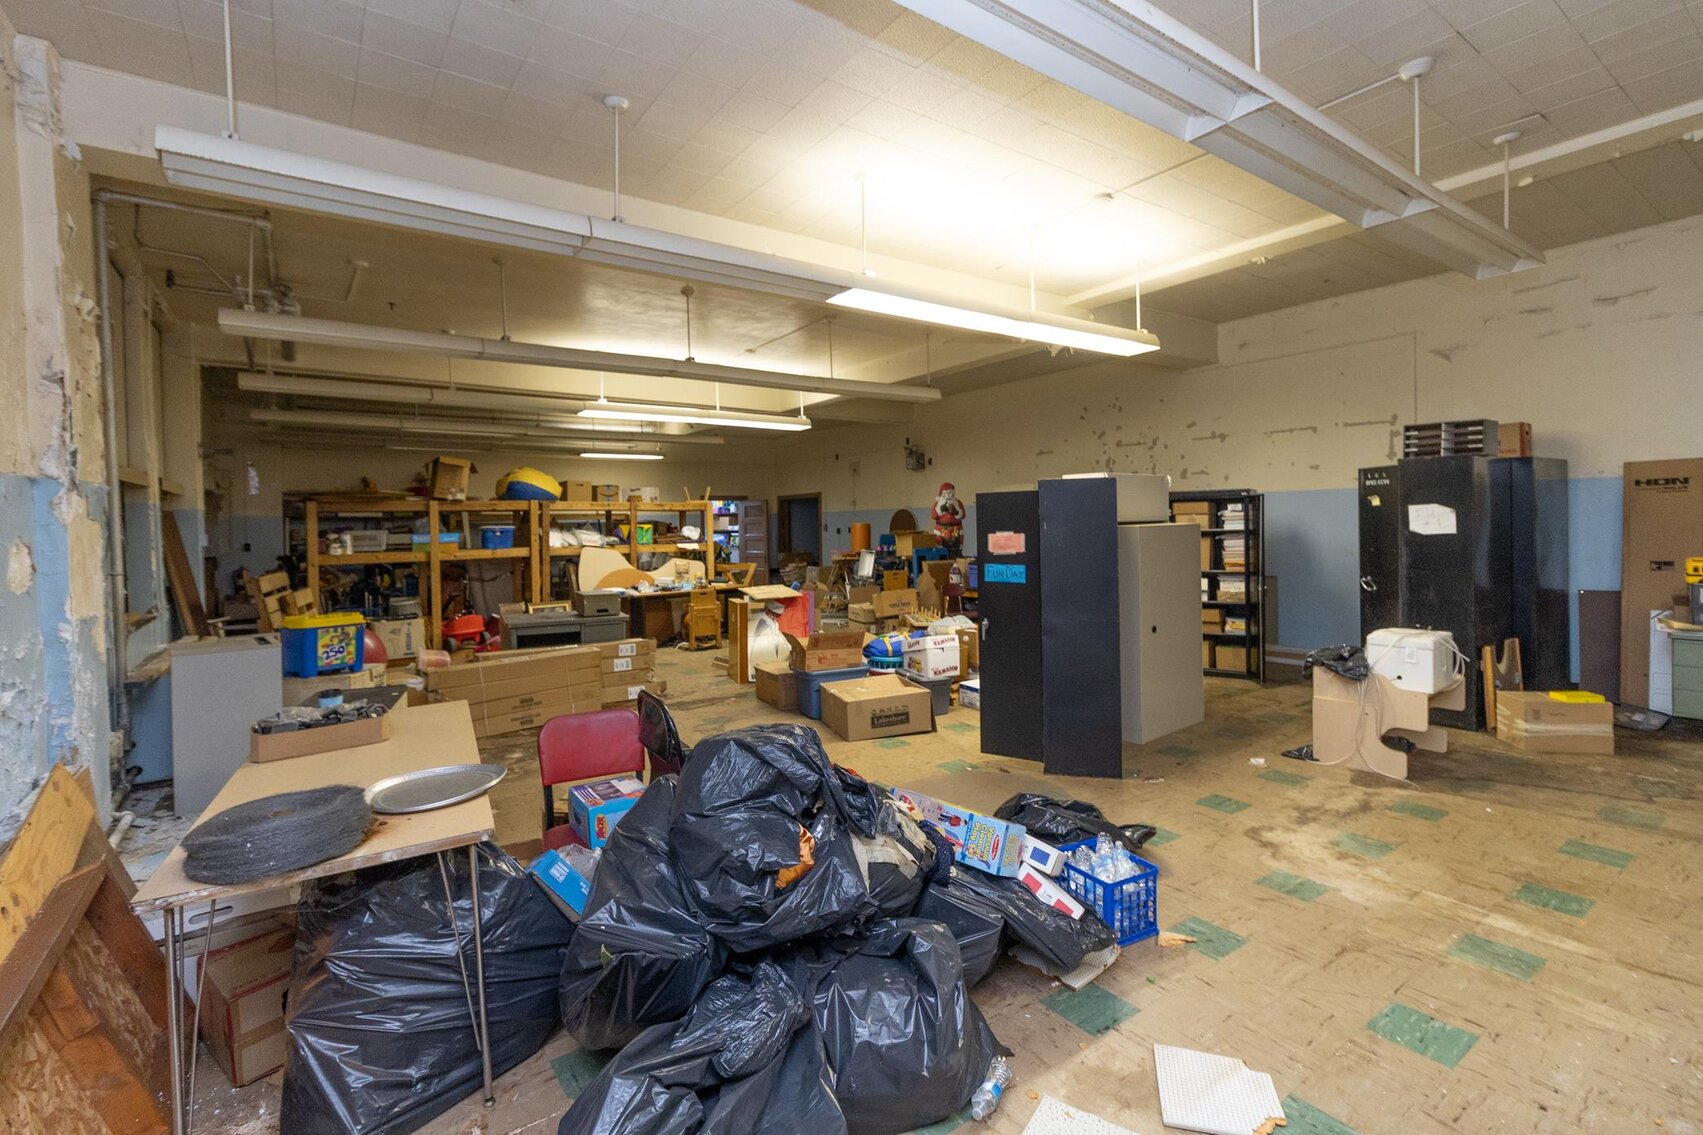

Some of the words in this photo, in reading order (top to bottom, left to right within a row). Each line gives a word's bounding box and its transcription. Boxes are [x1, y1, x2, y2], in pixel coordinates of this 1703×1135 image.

[1634, 477, 1690, 486] HON
[322, 645, 346, 660] 250
[970, 821, 980, 841] Play
[983, 827, 995, 862] Vacuum
